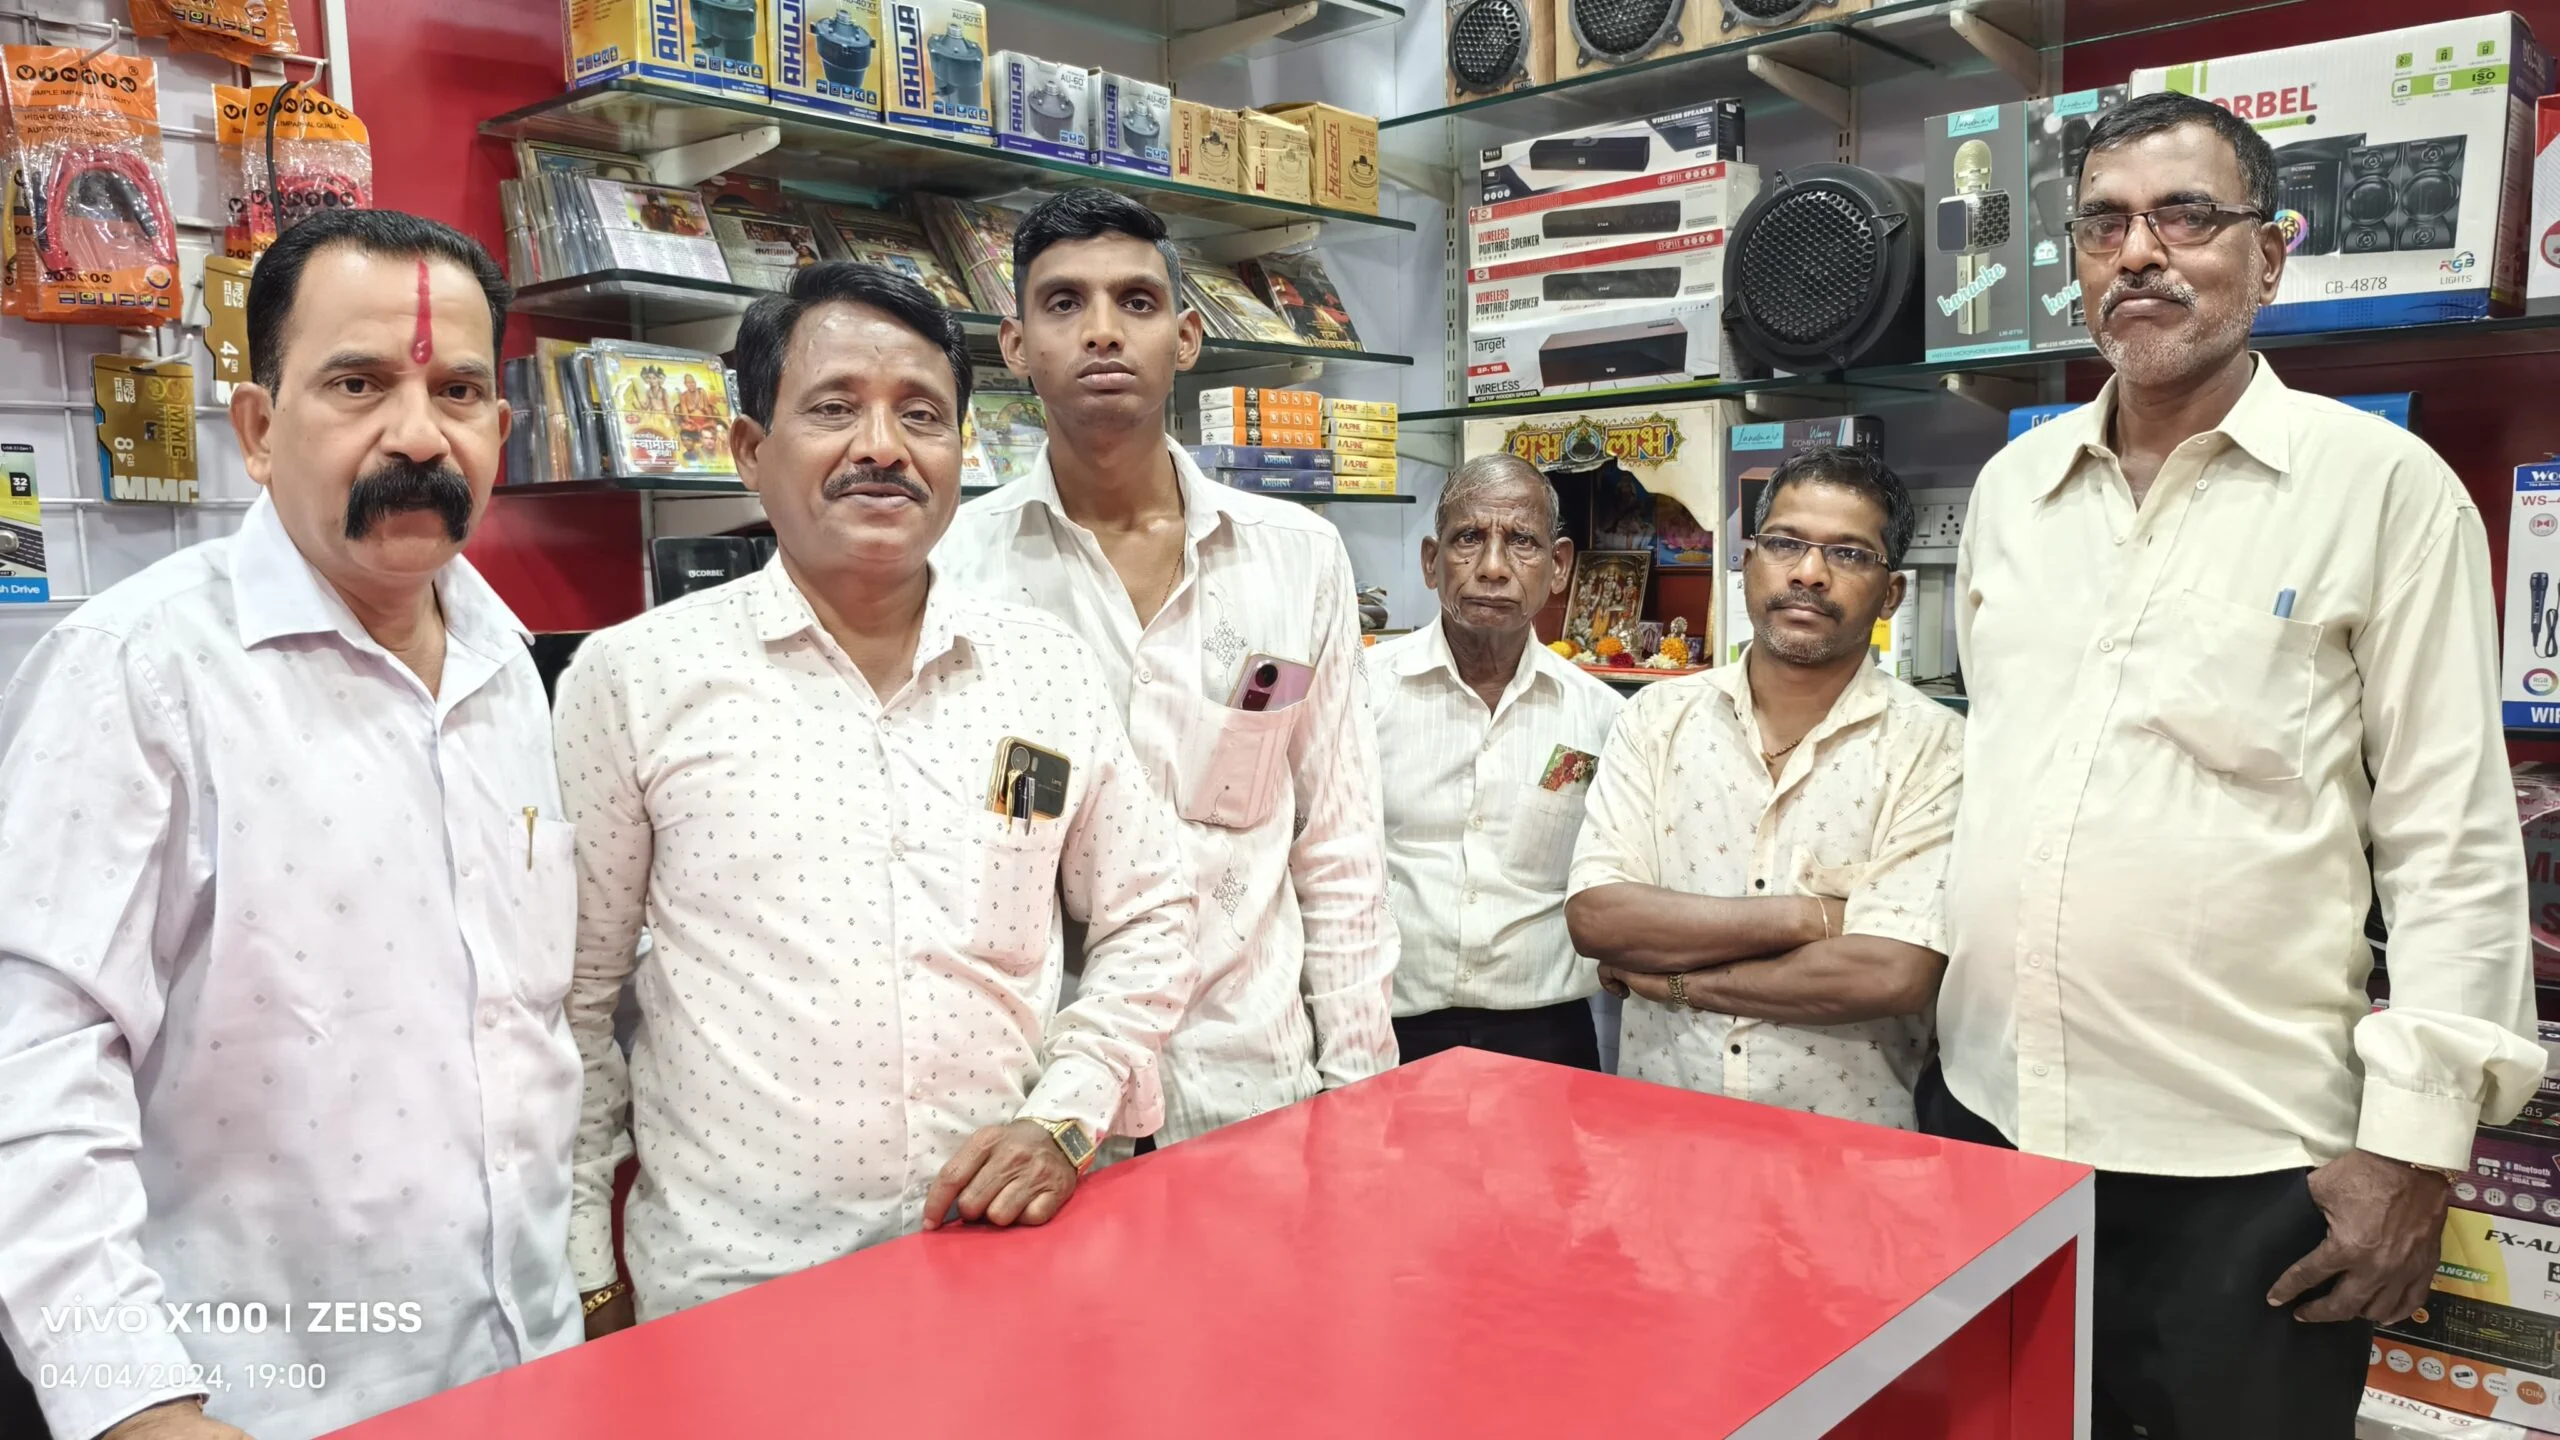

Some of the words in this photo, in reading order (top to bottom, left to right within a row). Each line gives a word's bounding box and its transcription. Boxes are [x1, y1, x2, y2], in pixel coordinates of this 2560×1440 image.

[899, 5, 921, 109] AHUJA
[2471, 70, 2496, 82] ISO
[1011, 62, 1022, 133] AHUJA
[1106, 84, 1118, 149] AHUJA
[1652, 112, 1683, 124] WIRELESS
[1683, 106, 1714, 118] SPEAKER
[1477, 227, 1510, 243] WIRELESS
[1478, 240, 1510, 255] PORTABLE
[1511, 234, 1540, 250] SPEAKER
[2440, 257, 2475, 273] RGB
[2324, 276, 2388, 295] CB-4878
[2440, 275, 2472, 285] LIGHTS
[1475, 289, 1510, 304] WIRELESS
[1937, 263, 2006, 317] karaoke
[1475, 301, 1509, 316] PORTABLE
[1509, 296, 1540, 311] SPEAKER
[220, 340, 239, 356] 4
[1473, 336, 1506, 353] Target
[1474, 380, 1521, 395] WIRELESS
[113, 437, 134, 450] 8
[1514, 431, 1564, 465] शुभ
[1604, 423, 1669, 458] लाभ
[126, 453, 135, 467] GB
[13, 477, 28, 486] 32
[11, 585, 41, 595] Drive
[2513, 1163, 2551, 1177] Bluetooth
[2520, 1387, 2544, 1399] 1DIN
